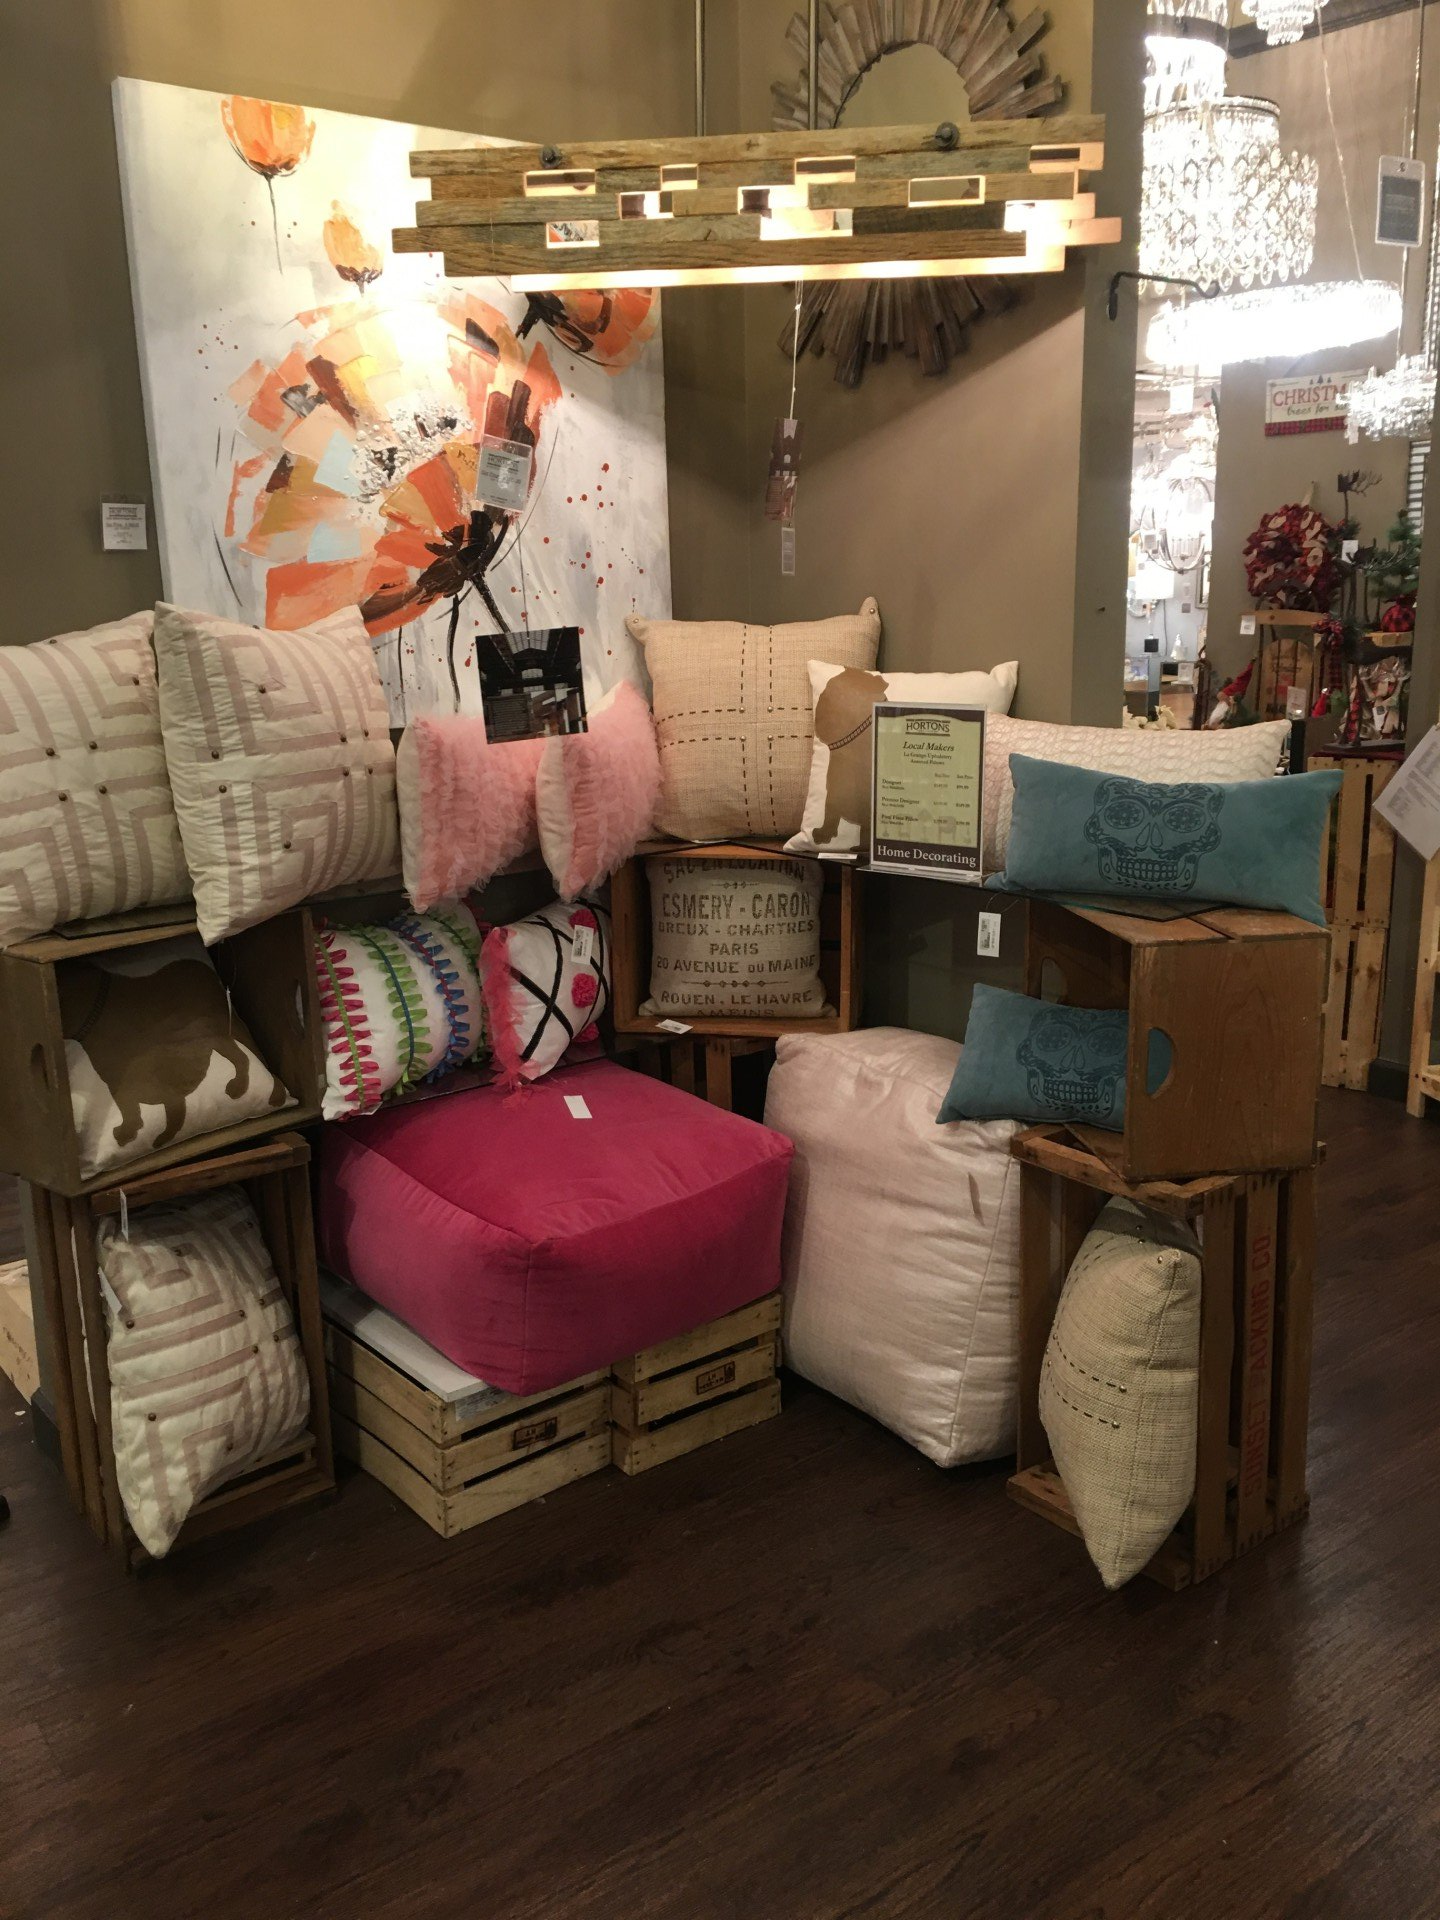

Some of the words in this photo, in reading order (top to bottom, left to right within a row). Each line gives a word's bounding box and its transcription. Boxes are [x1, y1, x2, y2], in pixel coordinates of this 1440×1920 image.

[1273, 383, 1347, 406] CHRISTM
[906, 721, 950, 733] HORTONS
[902, 741, 924, 751] Local
[926, 742, 955, 752] Makers
[877, 844, 911, 859] Home
[913, 849, 977, 869] Decorating
[662, 893, 734, 920] ESMERY
[751, 891, 810, 919] CARON
[727, 919, 815, 937] CHARTRES
[709, 943, 760, 956] PARIS
[673, 959, 740, 974] AVENUE
[768, 954, 816, 973] MAINE
[731, 994, 751, 1005] LE
[756, 989, 814, 1005] HAVRE
[1244, 1399, 1267, 1498] SUNSET
